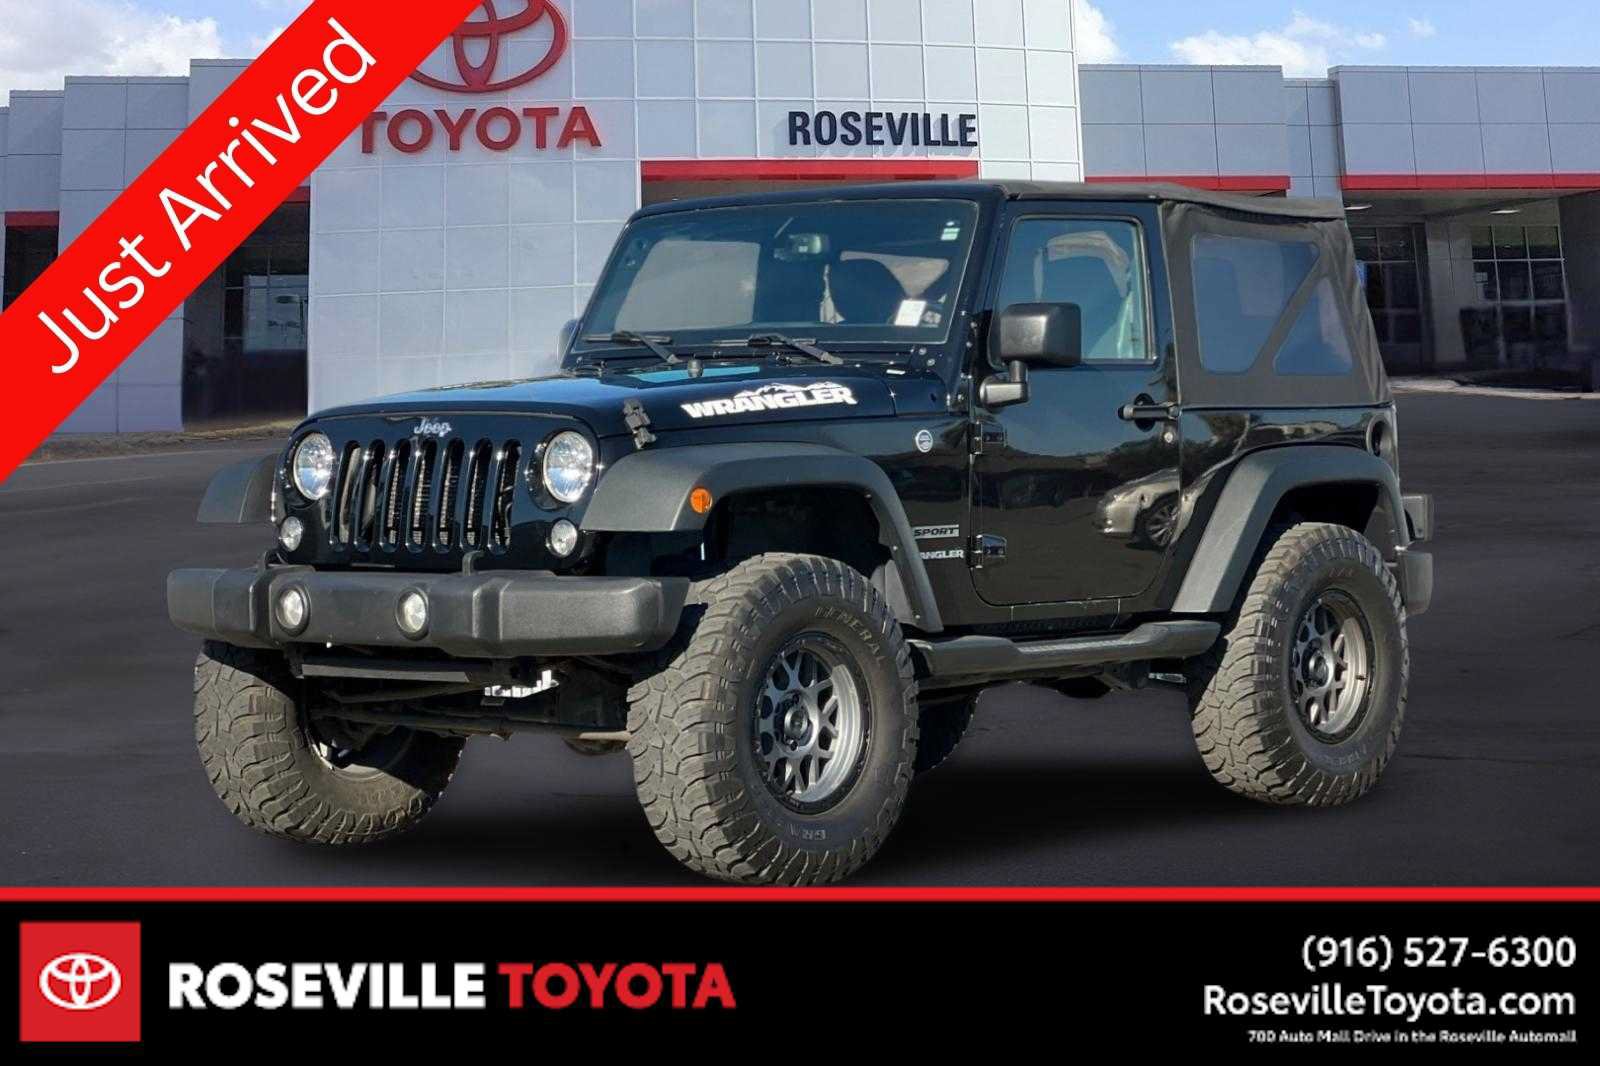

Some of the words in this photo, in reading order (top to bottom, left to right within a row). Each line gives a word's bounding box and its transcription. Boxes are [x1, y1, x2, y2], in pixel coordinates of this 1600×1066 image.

[360, 105, 603, 154] TOYOTA
[788, 110, 978, 147] ROSEVILLE
[681, 386, 858, 419] WRANGLER
[414, 418, 452, 438] Jeep
[913, 527, 956, 537] SPORT
[920, 549, 964, 560] ANGLER
